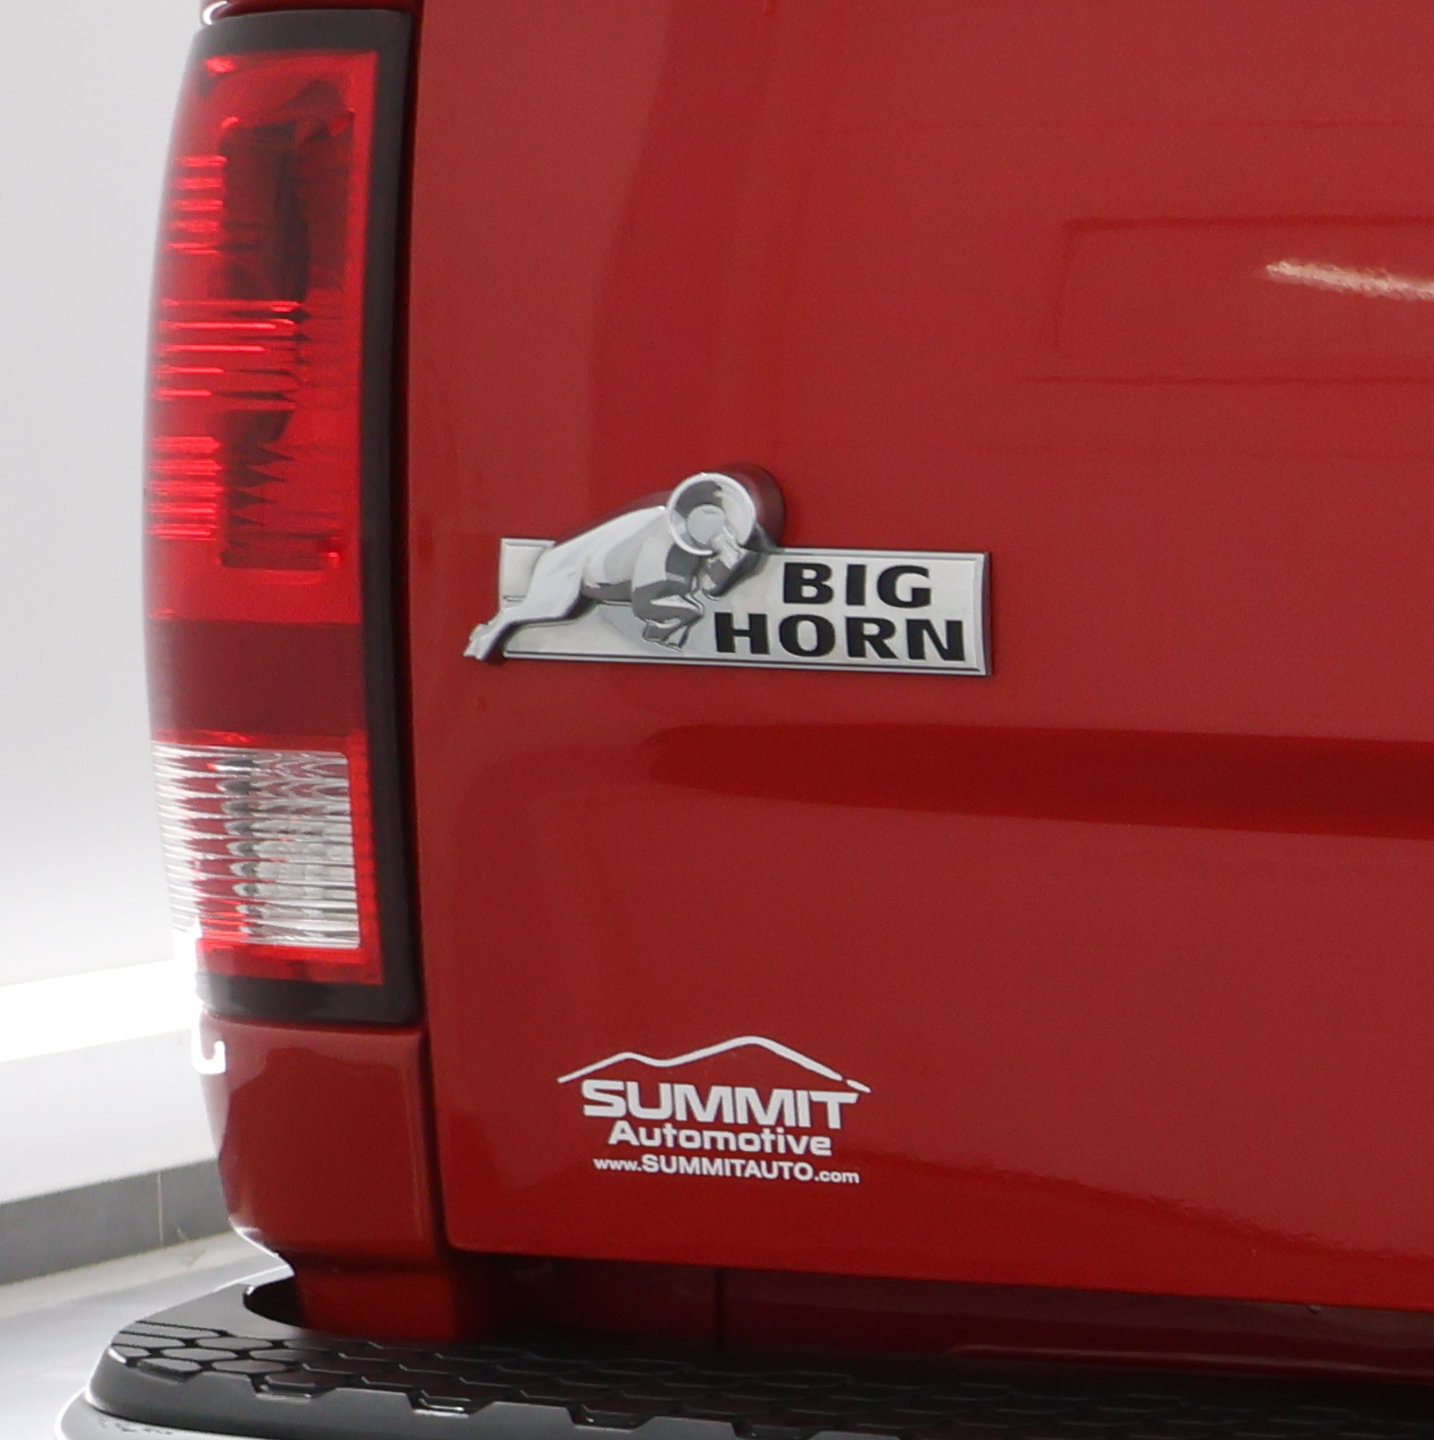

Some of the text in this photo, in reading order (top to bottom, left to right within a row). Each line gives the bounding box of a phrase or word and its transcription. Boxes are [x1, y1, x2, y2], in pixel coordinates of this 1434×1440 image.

[783, 562, 931, 608] BIG
[714, 613, 965, 661] HORN
[581, 1079, 859, 1129] SUMMIT
[609, 1120, 832, 1156] Automotive
[593, 1155, 860, 1184] www.SUMMITAUTO.com
